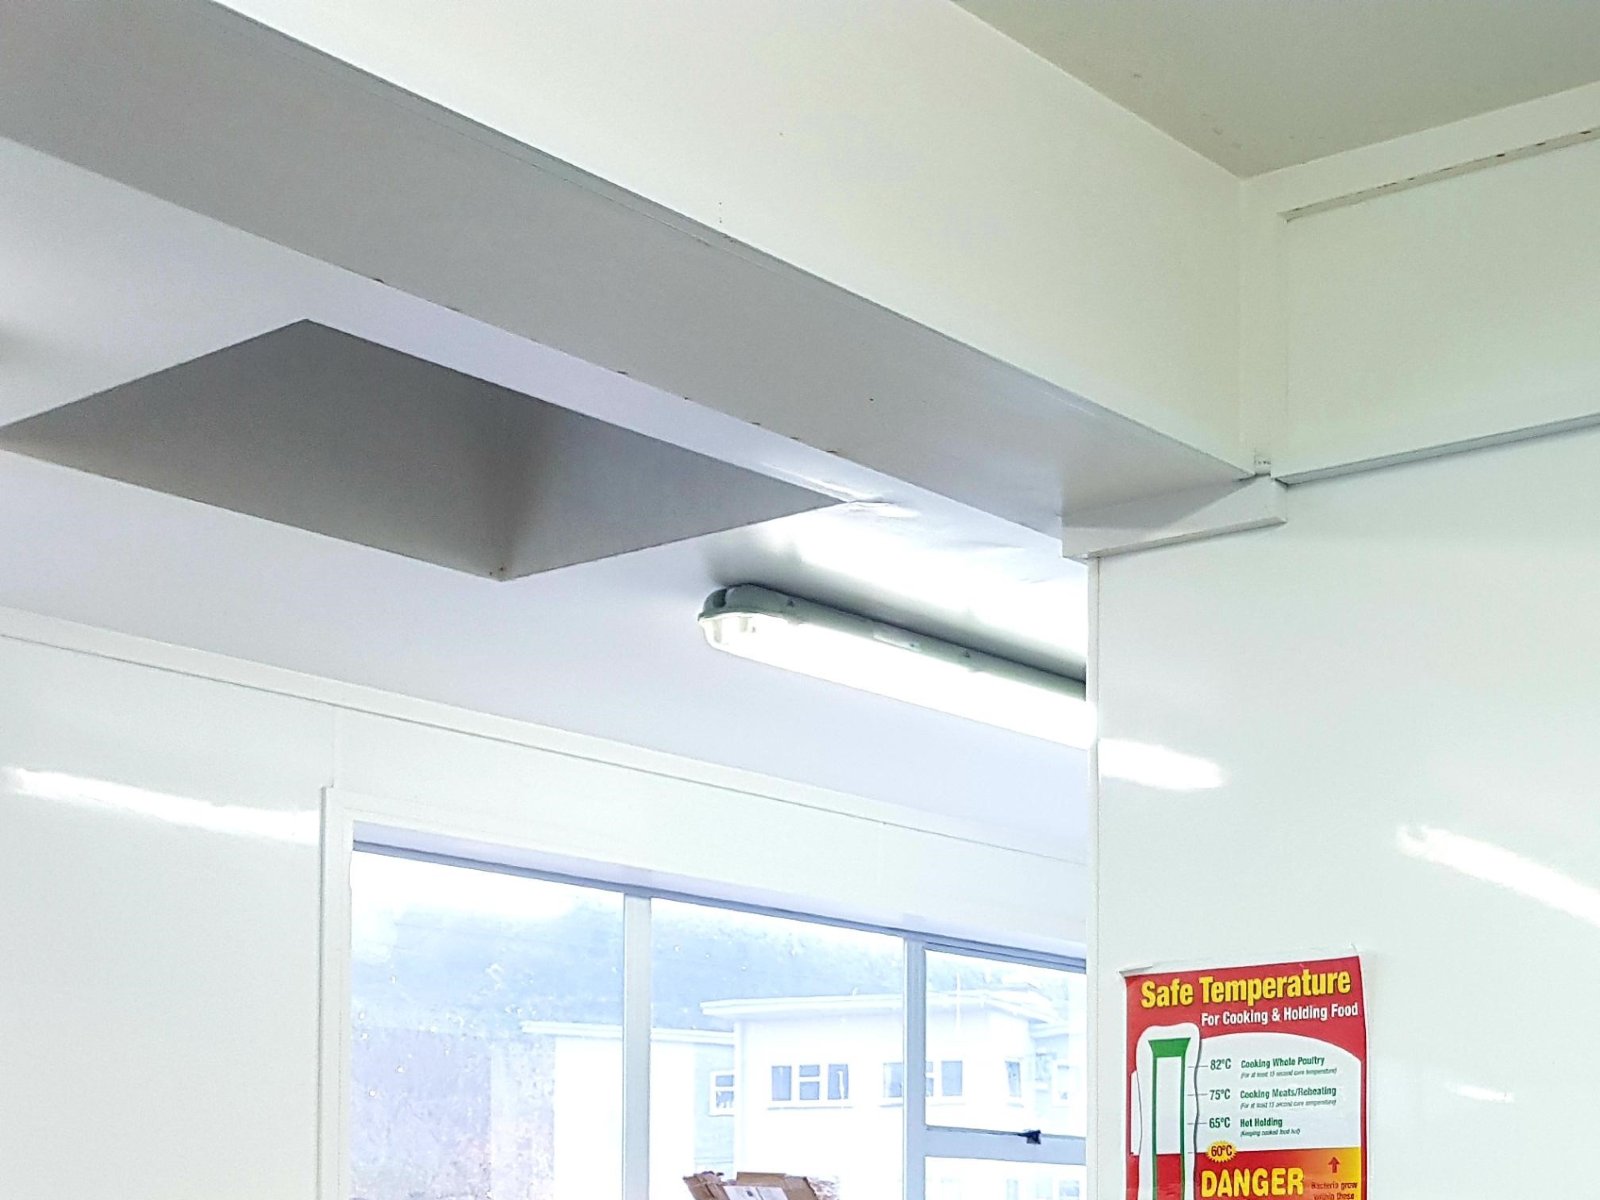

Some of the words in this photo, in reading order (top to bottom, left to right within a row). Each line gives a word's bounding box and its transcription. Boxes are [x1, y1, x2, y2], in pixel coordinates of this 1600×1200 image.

[1141, 978, 1195, 1009] Safe
[1198, 969, 1351, 1007] Temperature
[1201, 1012, 1220, 1026] For
[1222, 1009, 1268, 1025] Cooking
[1271, 1008, 1281, 1022] &
[1283, 1005, 1328, 1022] Holding
[1331, 1002, 1358, 1018] Food
[1240, 1059, 1271, 1071] Cooking
[1272, 1057, 1296, 1067] Whole
[1297, 1056, 1325, 1067] Poultry
[1240, 1090, 1270, 1100] Cooking
[1239, 1118, 1253, 1128] Hot
[1254, 1117, 1283, 1128] Holding
[1200, 1167, 1305, 1197] DANGER
[1311, 1181, 1339, 1190] Bacteria
[1340, 1182, 1358, 1190] grow
